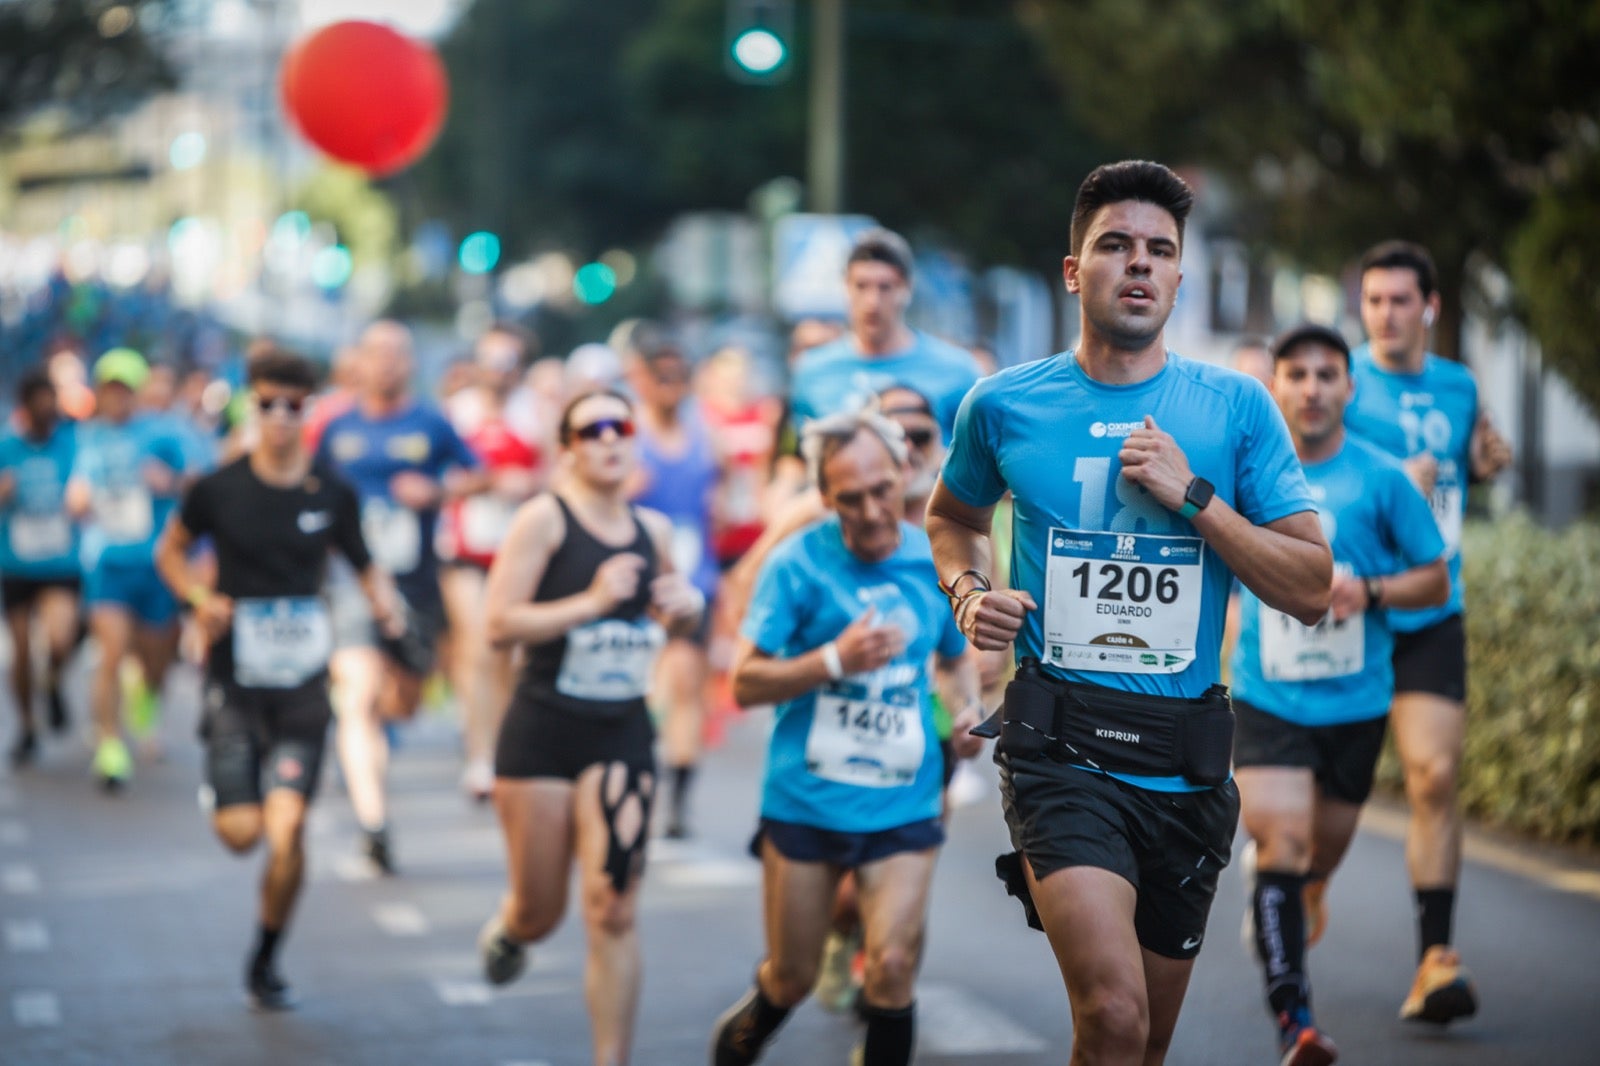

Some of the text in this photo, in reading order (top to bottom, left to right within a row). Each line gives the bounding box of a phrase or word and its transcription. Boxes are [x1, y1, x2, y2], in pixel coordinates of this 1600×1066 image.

[1107, 422, 1146, 431] OXIMES
[1072, 561, 1179, 604] 1206
[1096, 603, 1152, 617] EDUARDO
[1096, 728, 1140, 743] KIPRUN
